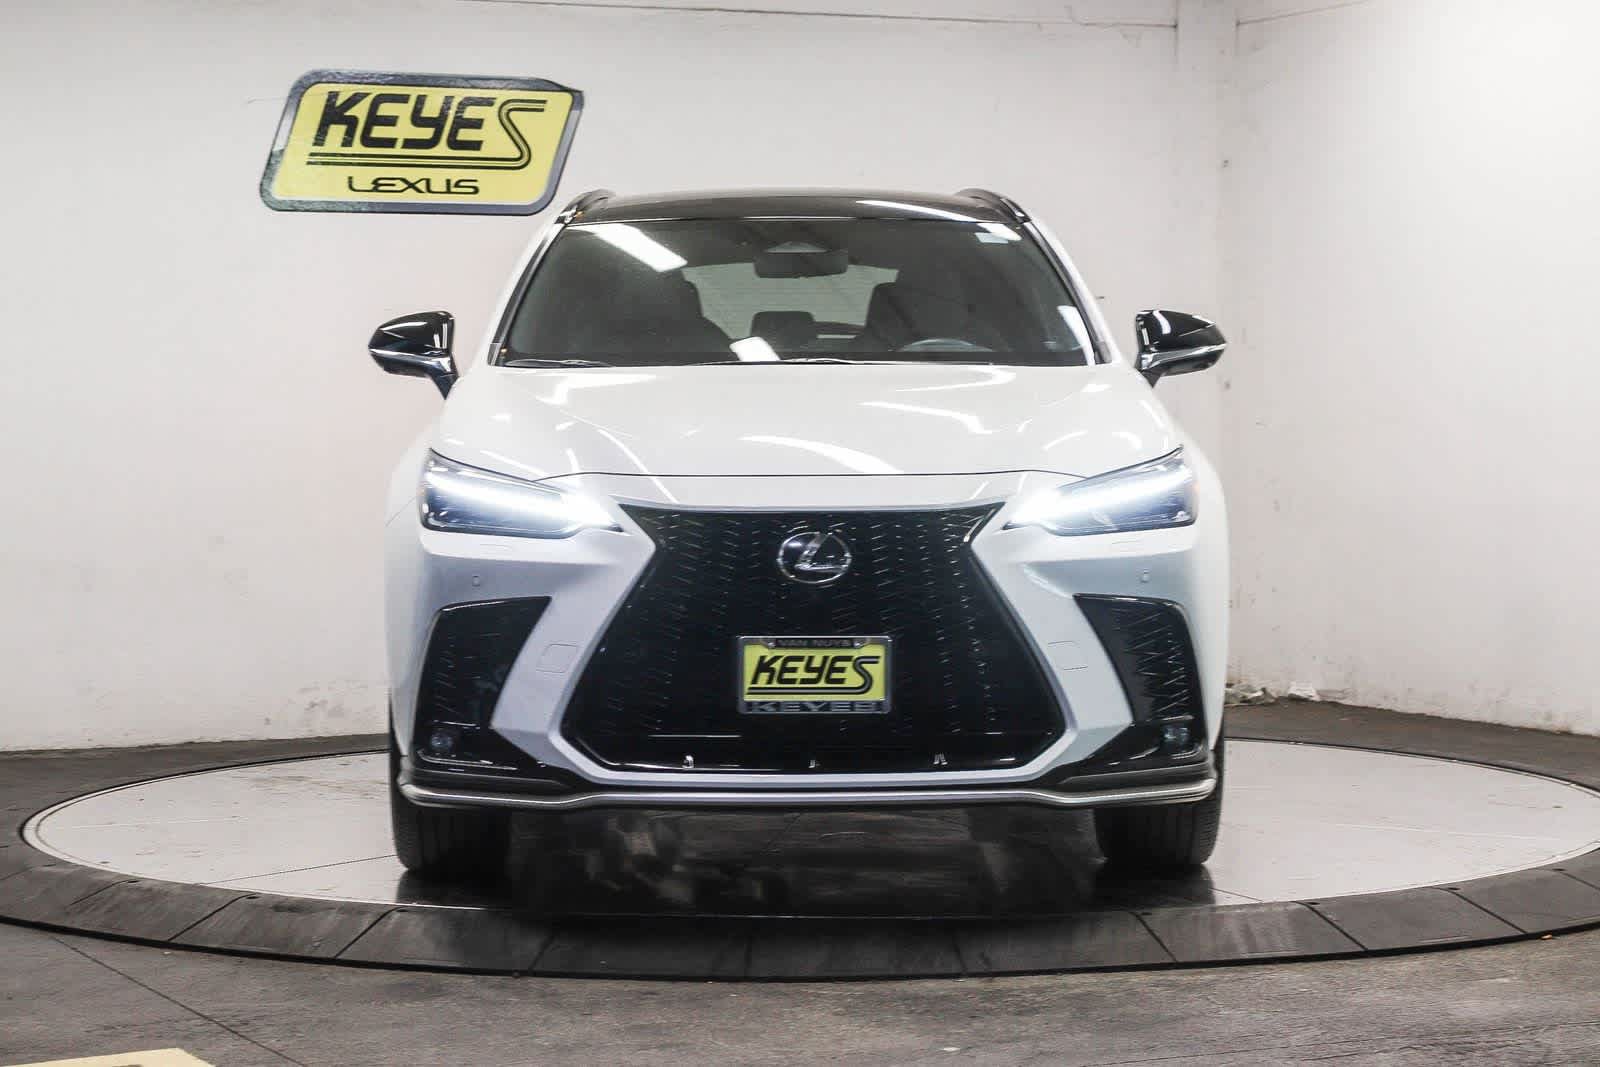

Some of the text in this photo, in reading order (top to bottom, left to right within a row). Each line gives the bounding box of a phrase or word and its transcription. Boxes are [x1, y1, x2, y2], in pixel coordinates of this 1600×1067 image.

[306, 90, 548, 171] KEYES
[347, 176, 480, 195] LEXUS
[746, 655, 880, 695] KEYES
[753, 702, 876, 712] KEYES
